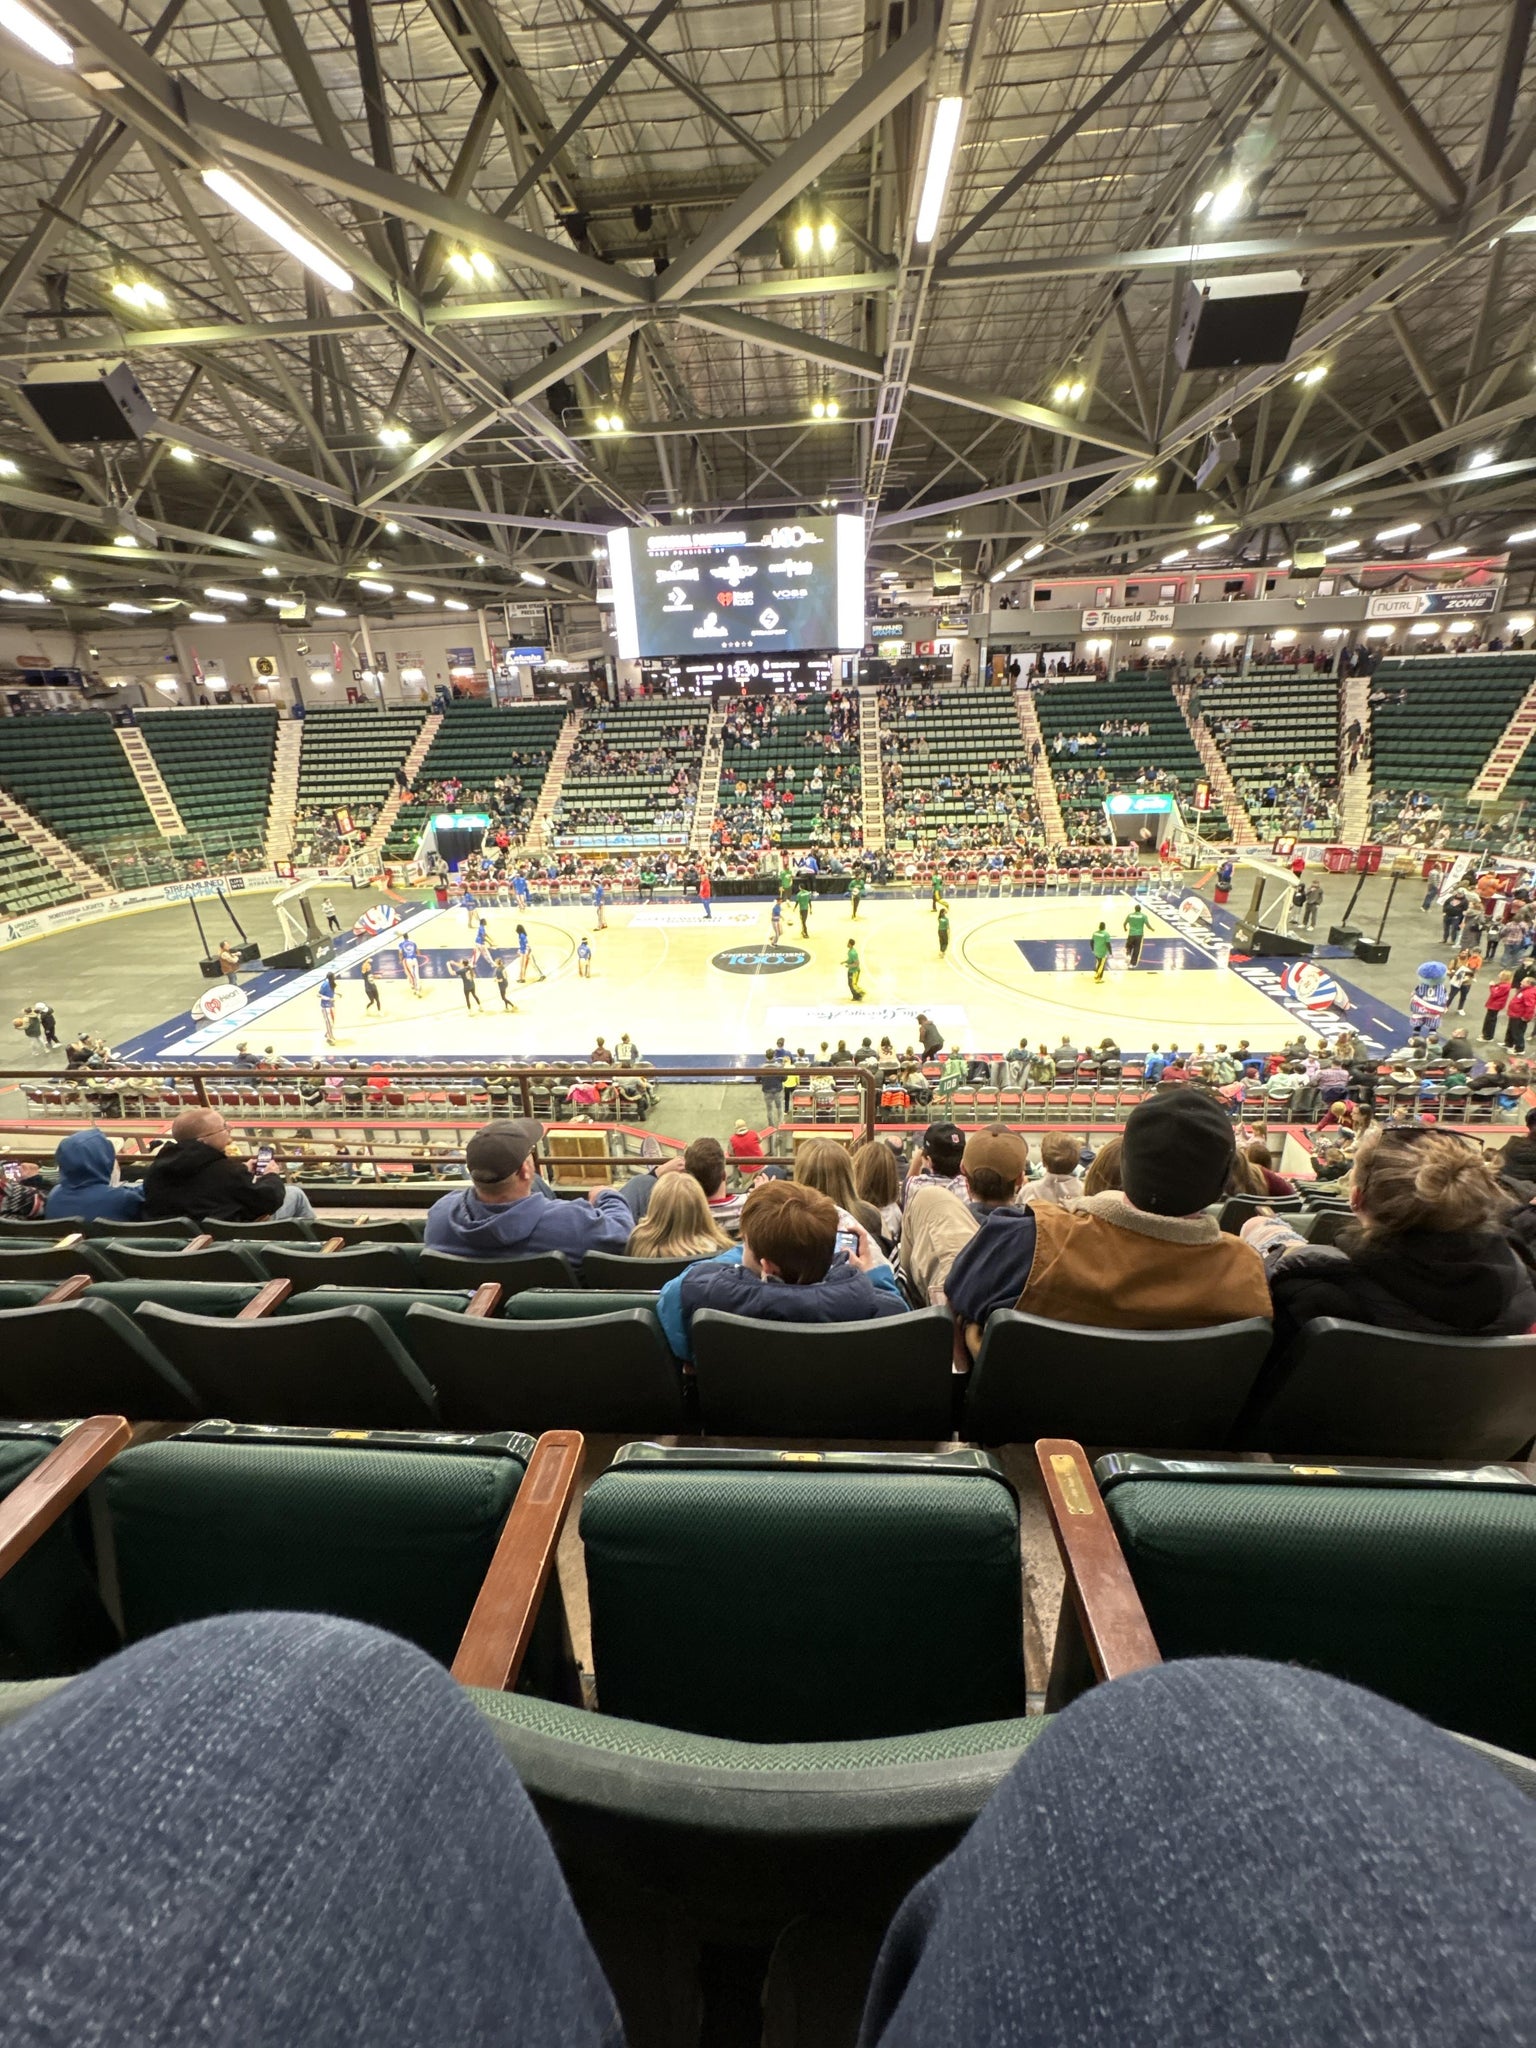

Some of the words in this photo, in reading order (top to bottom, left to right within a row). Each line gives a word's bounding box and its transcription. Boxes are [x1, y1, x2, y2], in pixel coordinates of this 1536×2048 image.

[1445, 598, 1487, 609] ZONE
[1102, 611, 1141, 625] Fitzgerald
[1148, 609, 1171, 622] Bros.
[920, 642, 930, 654] G
[941, 645, 949, 653] X
[355, 671, 361, 679] D
[741, 687, 748, 695] 0
[164, 879, 224, 893] STREAMLINED
[166, 887, 226, 901] GRAPHICS
[82, 902, 104, 911] LIGHTS
[1234, 967, 1291, 996] NEW
